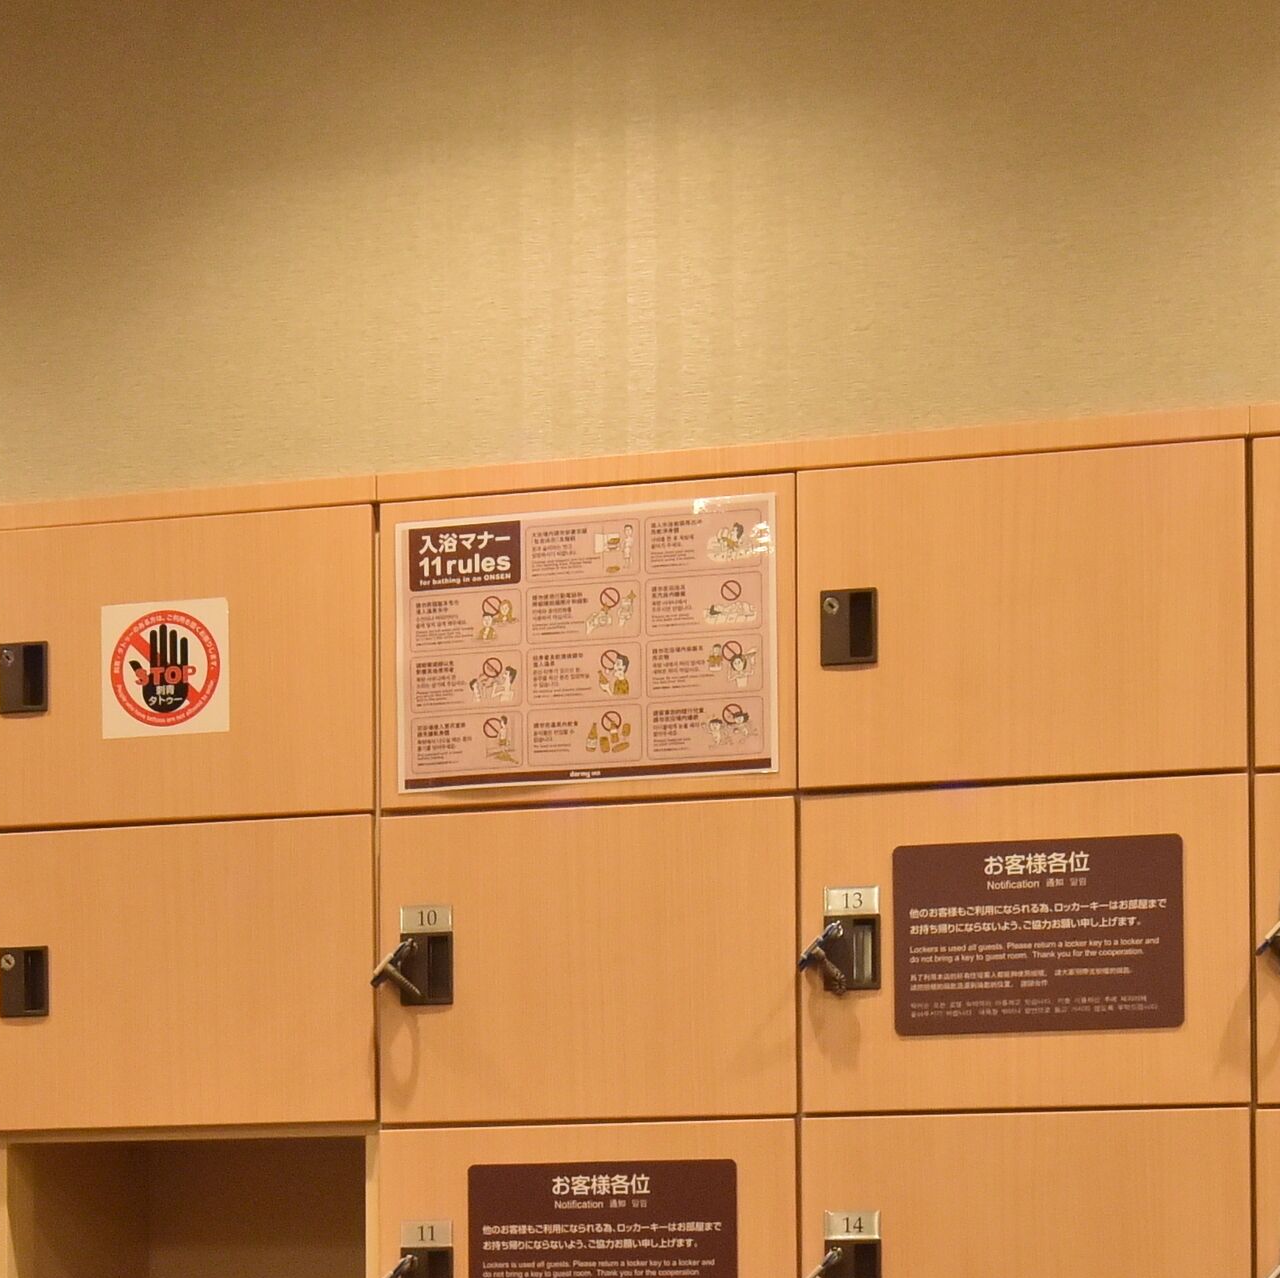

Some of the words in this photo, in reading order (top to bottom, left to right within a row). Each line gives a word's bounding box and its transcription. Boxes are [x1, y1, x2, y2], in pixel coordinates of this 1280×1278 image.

[419, 531, 511, 554] 入浴マナー
[419, 556, 442, 577] 11
[447, 553, 511, 576] rules
[484, 573, 511, 581] ONSEN
[135, 666, 197, 685] STOP
[148, 696, 183, 706] タトゥー
[983, 850, 1090, 876] お客様各位
[986, 878, 1039, 890] Notification
[842, 892, 863, 909] 13
[418, 910, 437, 927] 10
[551, 1173, 651, 1196] お客様各位
[554, 1199, 603, 1209] Notification
[417, 1225, 435, 1241] 11
[843, 1216, 864, 1233] 14
